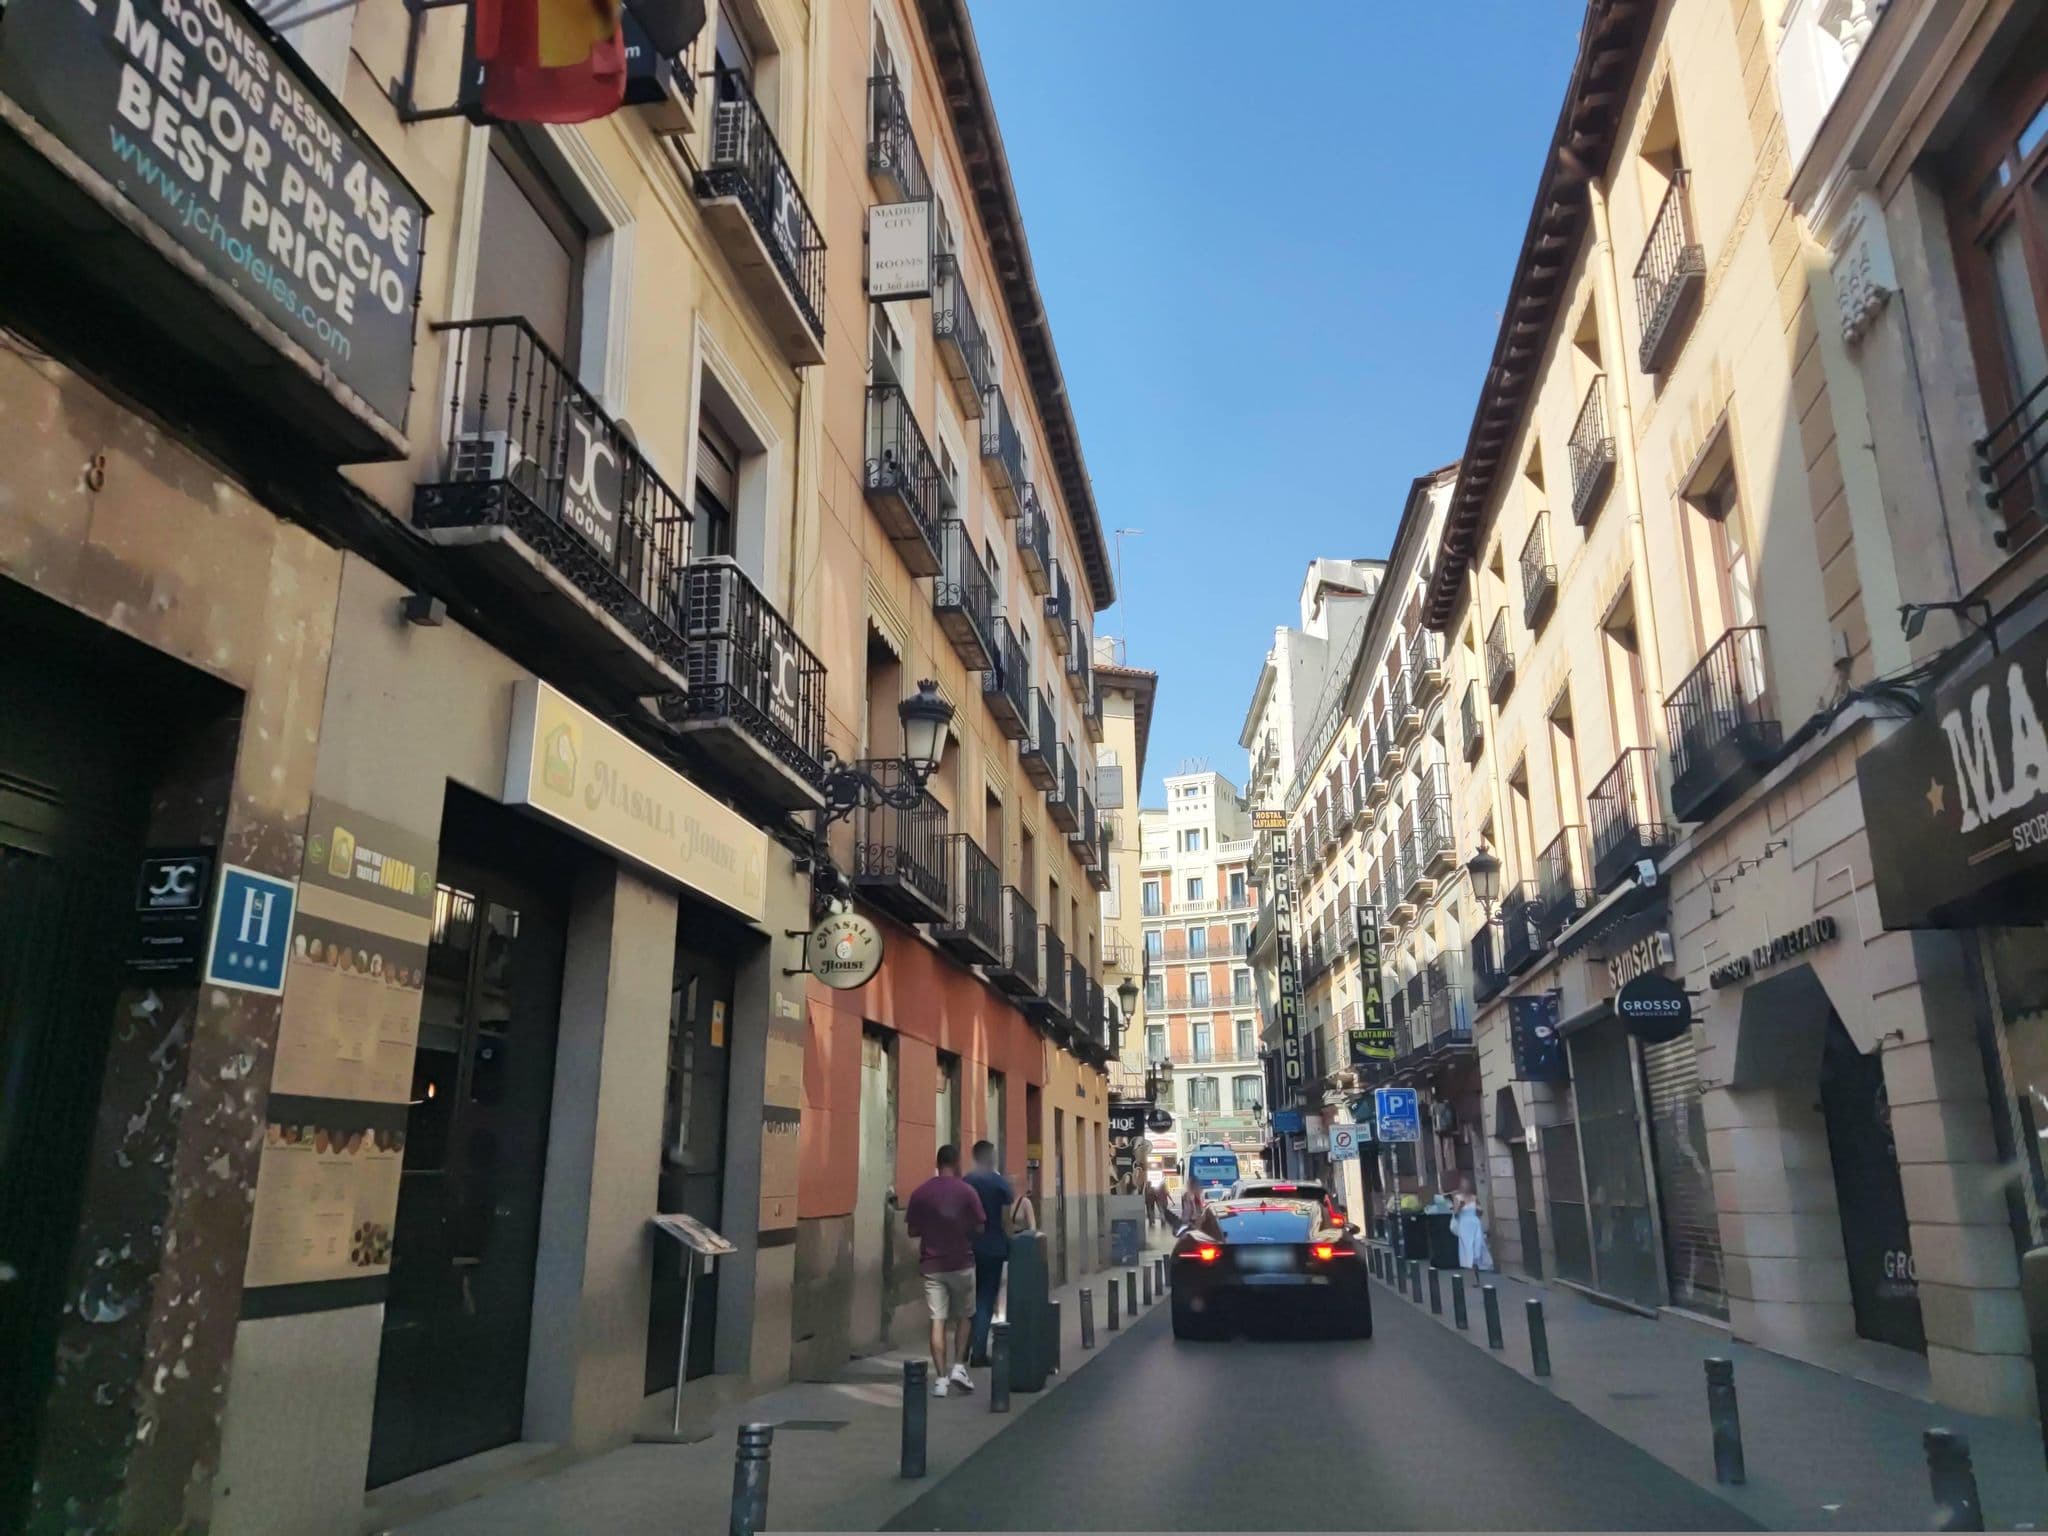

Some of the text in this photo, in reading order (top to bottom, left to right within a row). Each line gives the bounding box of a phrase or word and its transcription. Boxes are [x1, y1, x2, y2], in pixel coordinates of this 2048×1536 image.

[162, 0, 334, 190] ROOMS FROM
[194, 0, 342, 163] ONES DESDE
[114, 0, 404, 315] MEJOR PRECIO
[117, 64, 357, 325] BEST PRICE
[343, 158, 412, 266] 45€
[874, 206, 926, 218] MADRID
[110, 124, 352, 361] www.jchoteles.com
[884, 218, 913, 230] CITY
[875, 257, 924, 270] ROOMS
[569, 418, 615, 522] JC
[564, 495, 613, 553] ROOMS
[771, 640, 796, 708] JC
[769, 698, 795, 731] ROOMS
[1941, 656, 2048, 834] MA
[585, 760, 677, 840] MASALA
[1253, 819, 1286, 829] CANTABRICO
[1256, 811, 1283, 820] HOSTAL
[1273, 835, 1286, 853] H
[149, 865, 196, 895] JC
[380, 855, 416, 896] INDIA
[236, 885, 277, 948] H
[817, 920, 873, 950] MASALA
[820, 959, 866, 975] HOUSE
[1275, 873, 1301, 1080] CANTABRICO
[1359, 909, 1381, 1024] HOSTAL
[1608, 932, 1665, 990] samsara
[1622, 999, 1682, 1012] GROSSO
[1389, 1095, 1403, 1114] P
[1209, 1157, 1219, 1165] M1
